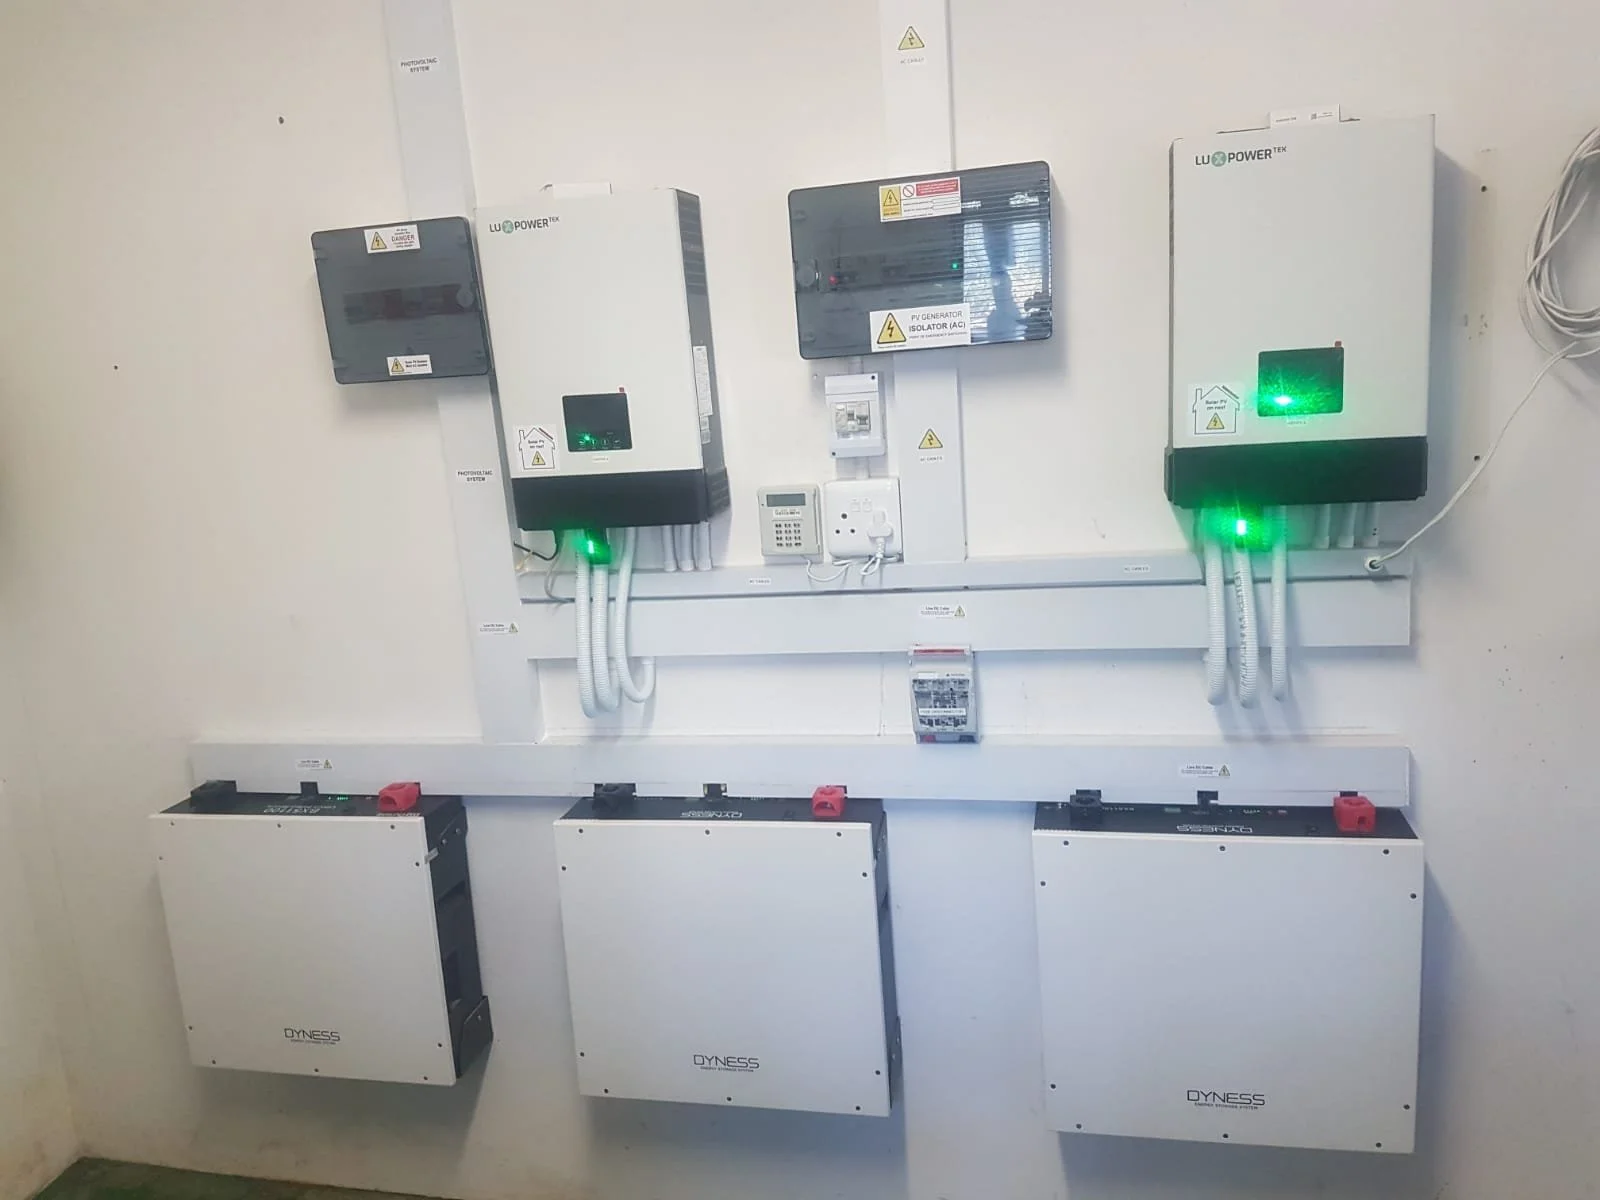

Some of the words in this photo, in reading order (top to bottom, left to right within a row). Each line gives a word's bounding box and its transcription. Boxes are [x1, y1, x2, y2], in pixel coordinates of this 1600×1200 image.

[921, 310, 963, 320] GENERATOR
[908, 322, 948, 332] ISOLATOR
[949, 321, 966, 330] (AC)
[1176, 824, 1253, 832] DYNESS
[284, 1028, 341, 1041] DYNESS
[693, 1054, 760, 1068] DYNESS
[1187, 1090, 1266, 1106] DYNESS
